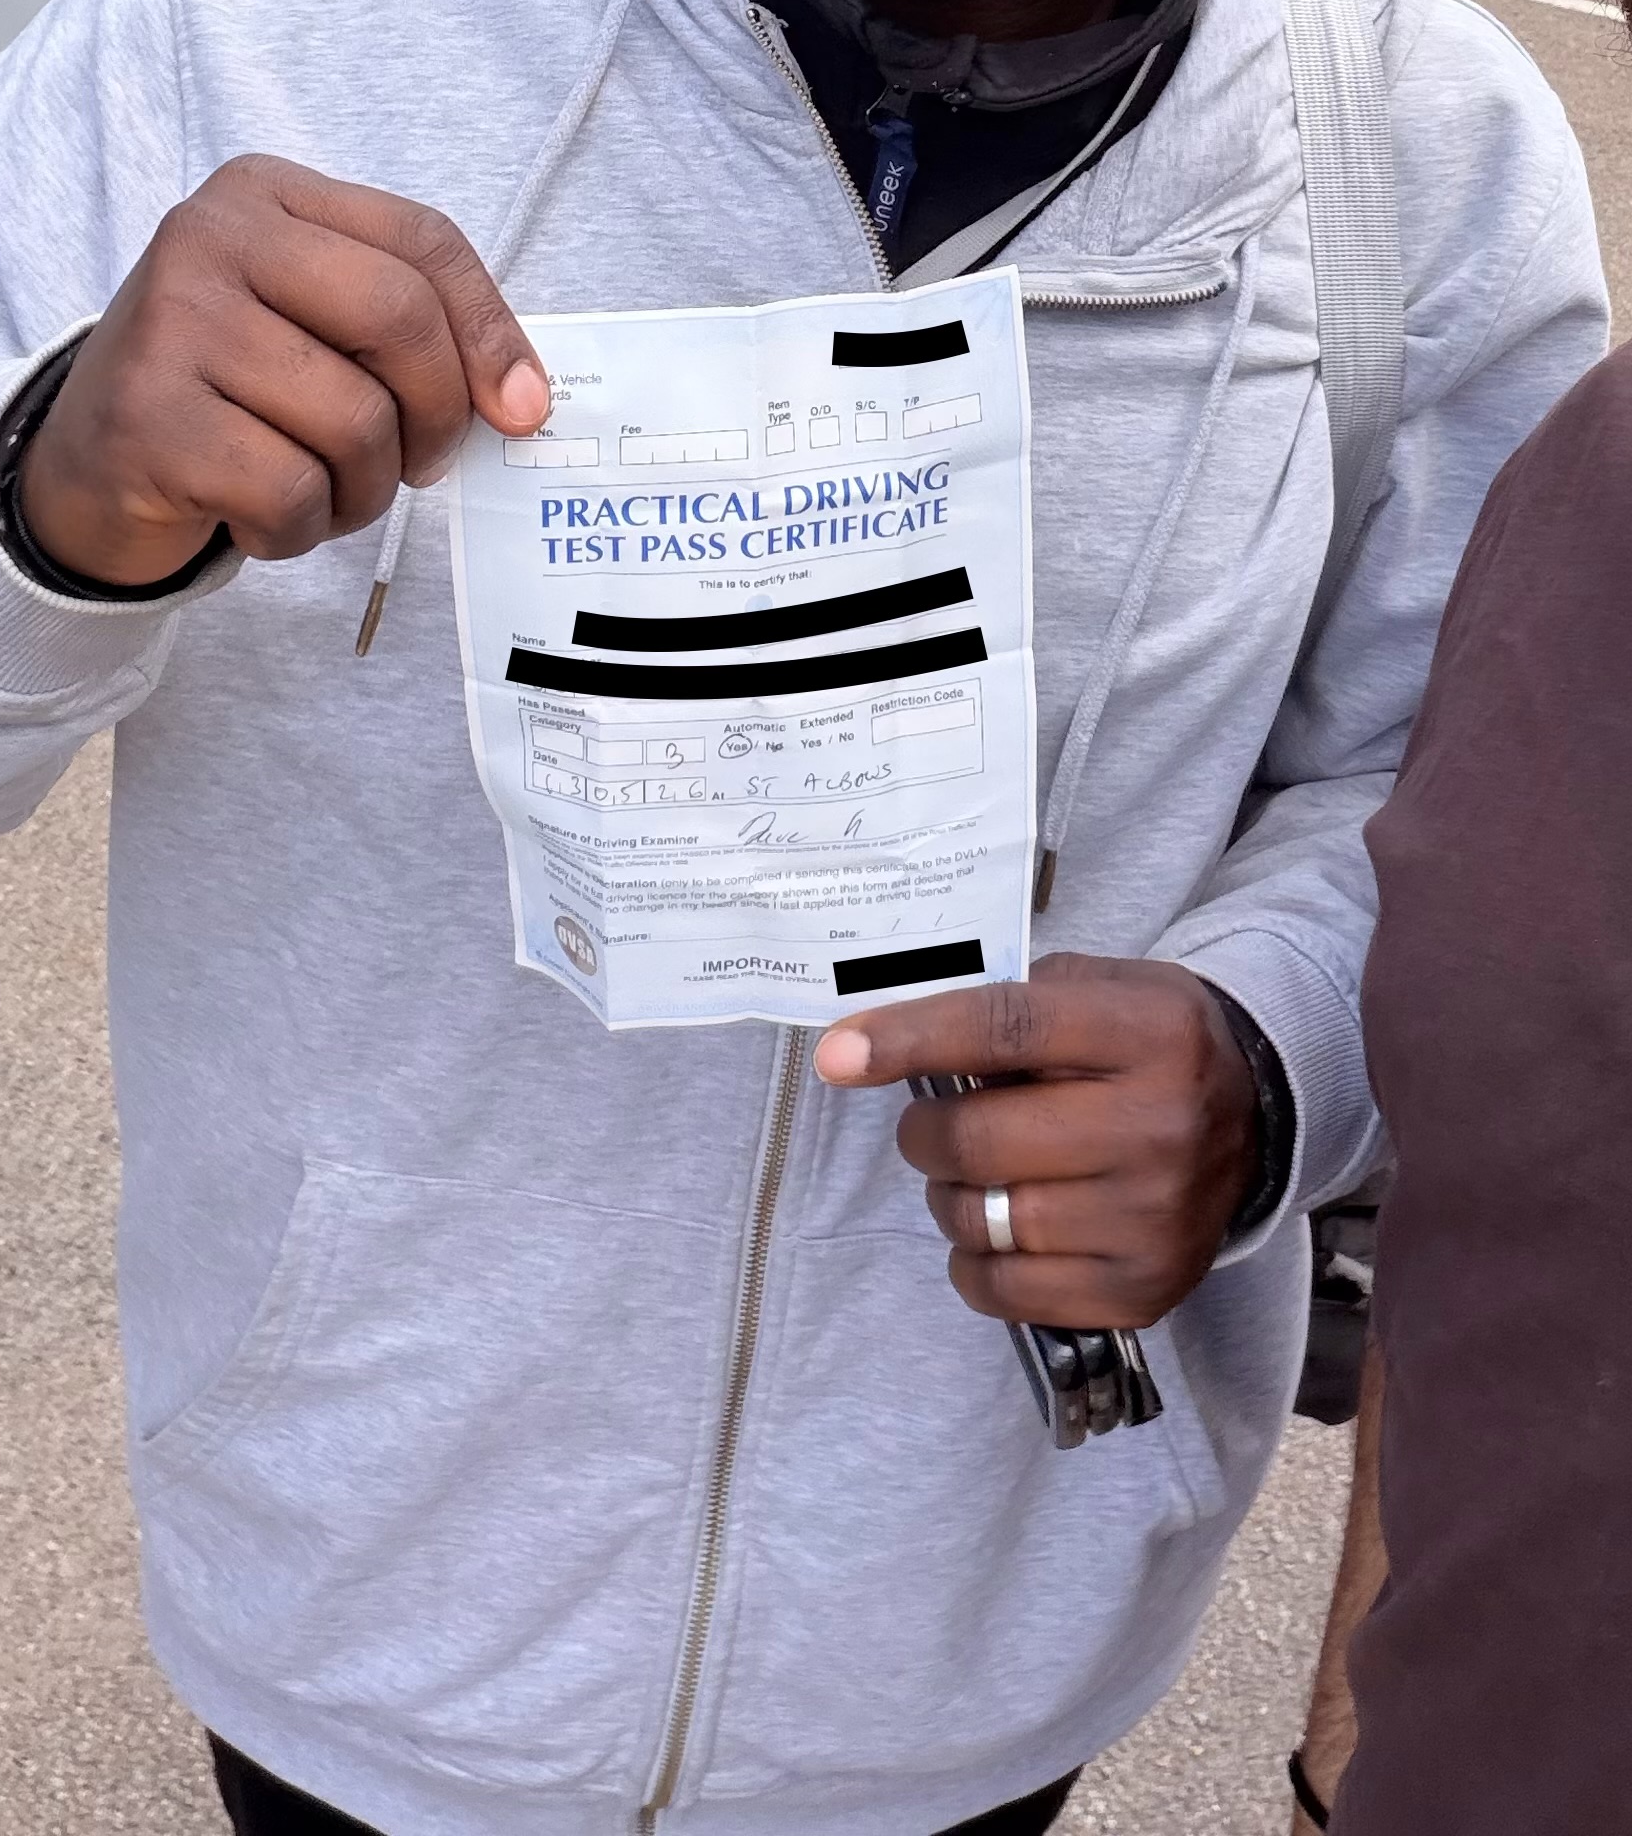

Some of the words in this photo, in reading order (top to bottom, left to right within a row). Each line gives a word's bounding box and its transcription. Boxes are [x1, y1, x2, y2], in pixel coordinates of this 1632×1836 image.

[875, 161, 906, 233] Uneek
[560, 373, 602, 385] Vehicle
[810, 405, 831, 416] O/D
[856, 400, 876, 411] S/C
[768, 412, 791, 425] Type
[621, 425, 642, 434] Fee
[541, 491, 768, 528] PRACTICAL
[784, 462, 950, 516] DRIVING
[541, 536, 626, 564] TEST
[641, 532, 727, 562] PASS
[740, 497, 948, 559] CERTIFICATE
[699, 580, 723, 589] This
[739, 580, 750, 588] to
[754, 574, 785, 588] certify
[512, 632, 546, 647] Name
[518, 696, 540, 709] Has
[543, 701, 586, 717] Passed
[871, 694, 930, 714] Restriction
[934, 687, 964, 702] Code
[529, 714, 581, 734] Category
[724, 722, 786, 734] Automatic
[800, 710, 854, 730] Extended
[726, 741, 748, 753] Yes
[801, 738, 822, 750] Yes
[838, 731, 855, 743] No
[533, 750, 558, 765] Date
[746, 776, 780, 797] ST
[528, 815, 577, 840] Signature
[580, 835, 591, 844] of
[594, 836, 637, 848] Driving
[641, 835, 699, 846] Examiner
[692, 878, 703, 887] to
[706, 877, 721, 886] be
[724, 871, 782, 886] completed
[795, 867, 840, 879] sending
[843, 865, 863, 875] this
[865, 861, 919, 873] certificate
[923, 860, 933, 869] to
[935, 855, 952, 866] the
[954, 846, 988, 863] DVLA)
[606, 893, 644, 904] driving
[647, 891, 687, 901] licence
[690, 891, 705, 900] for
[709, 891, 727, 900] the
[782, 887, 819, 898] shown
[822, 885, 836, 895] on
[840, 883, 860, 894] this
[863, 881, 888, 892] form
[891, 877, 911, 889] and
[914, 872, 954, 886] declare
[605, 905, 619, 914] no
[622, 903, 665, 913] change
[667, 901, 678, 910] in
[740, 899, 770, 910] since
[780, 901, 800, 910] last
[803, 898, 844, 911] applied
[848, 896, 863, 906] for
[829, 929, 860, 940] Date:
[703, 956, 810, 975] IMPORTANT
